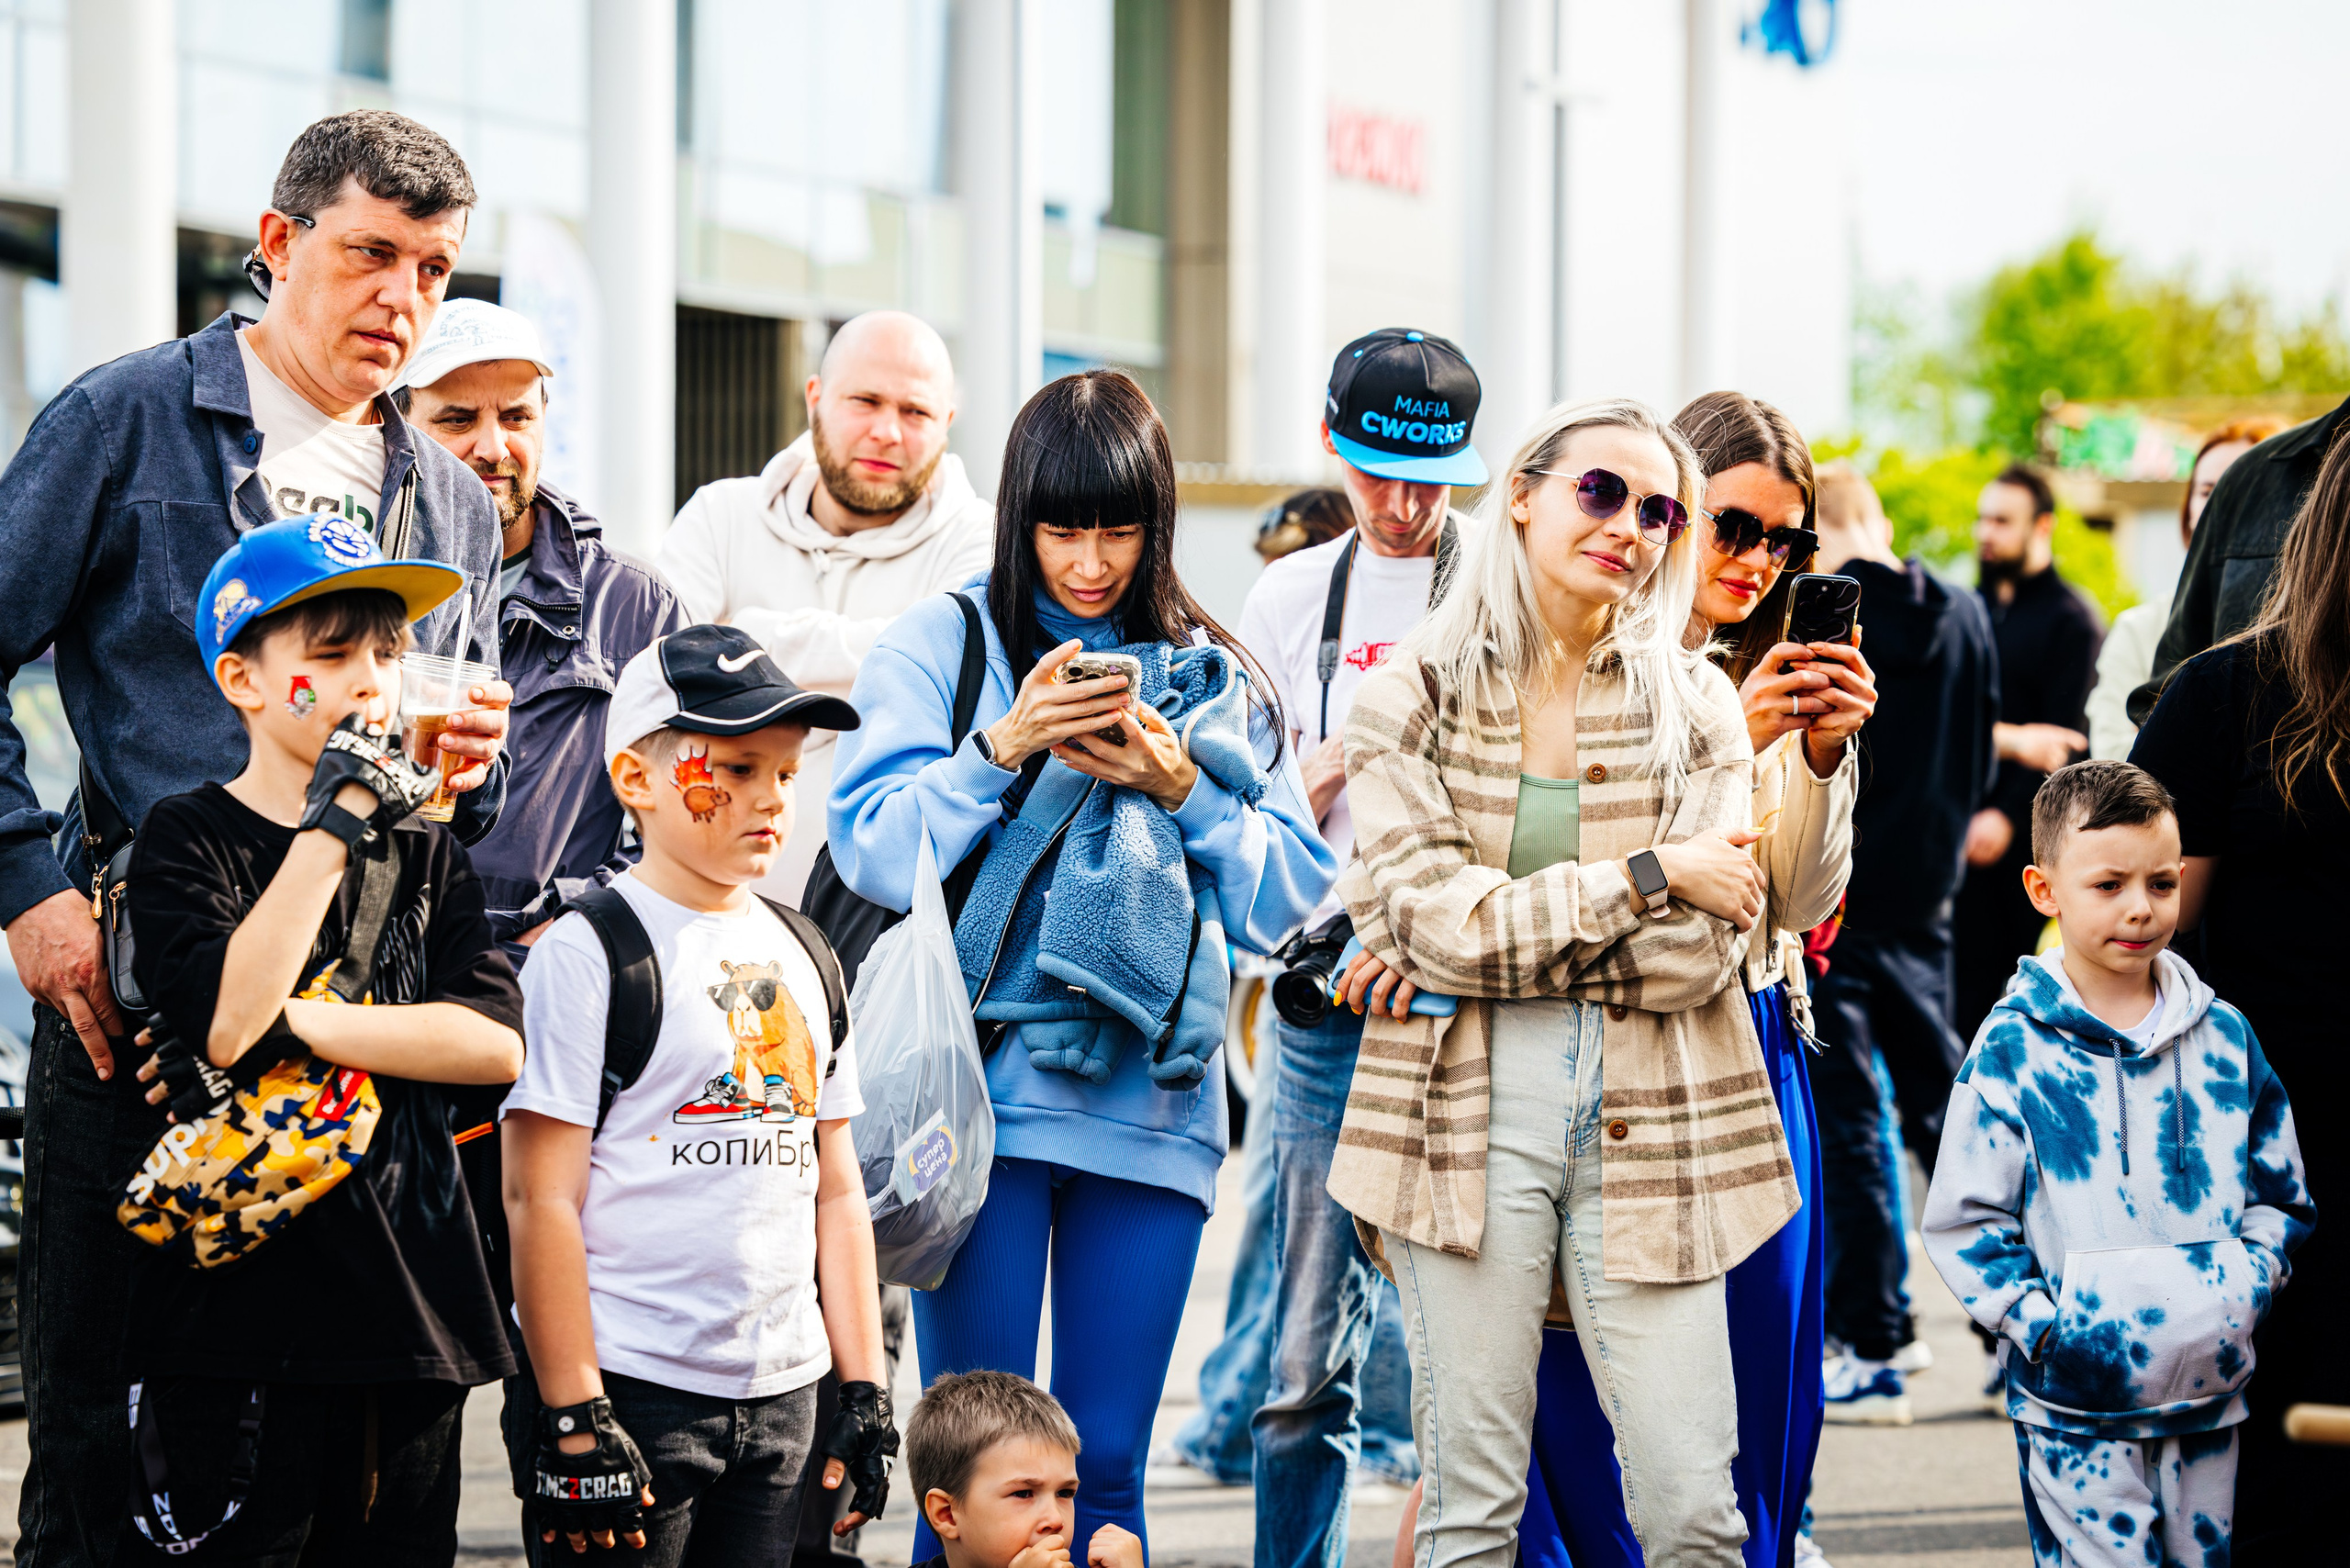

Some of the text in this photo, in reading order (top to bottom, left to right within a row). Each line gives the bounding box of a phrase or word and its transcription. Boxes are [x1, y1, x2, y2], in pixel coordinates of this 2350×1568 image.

[1394, 395, 1450, 418] MAFIA
[1361, 410, 1467, 445] CWORKS
[917, 1138, 945, 1169] супер
[923, 1151, 947, 1178] цена
